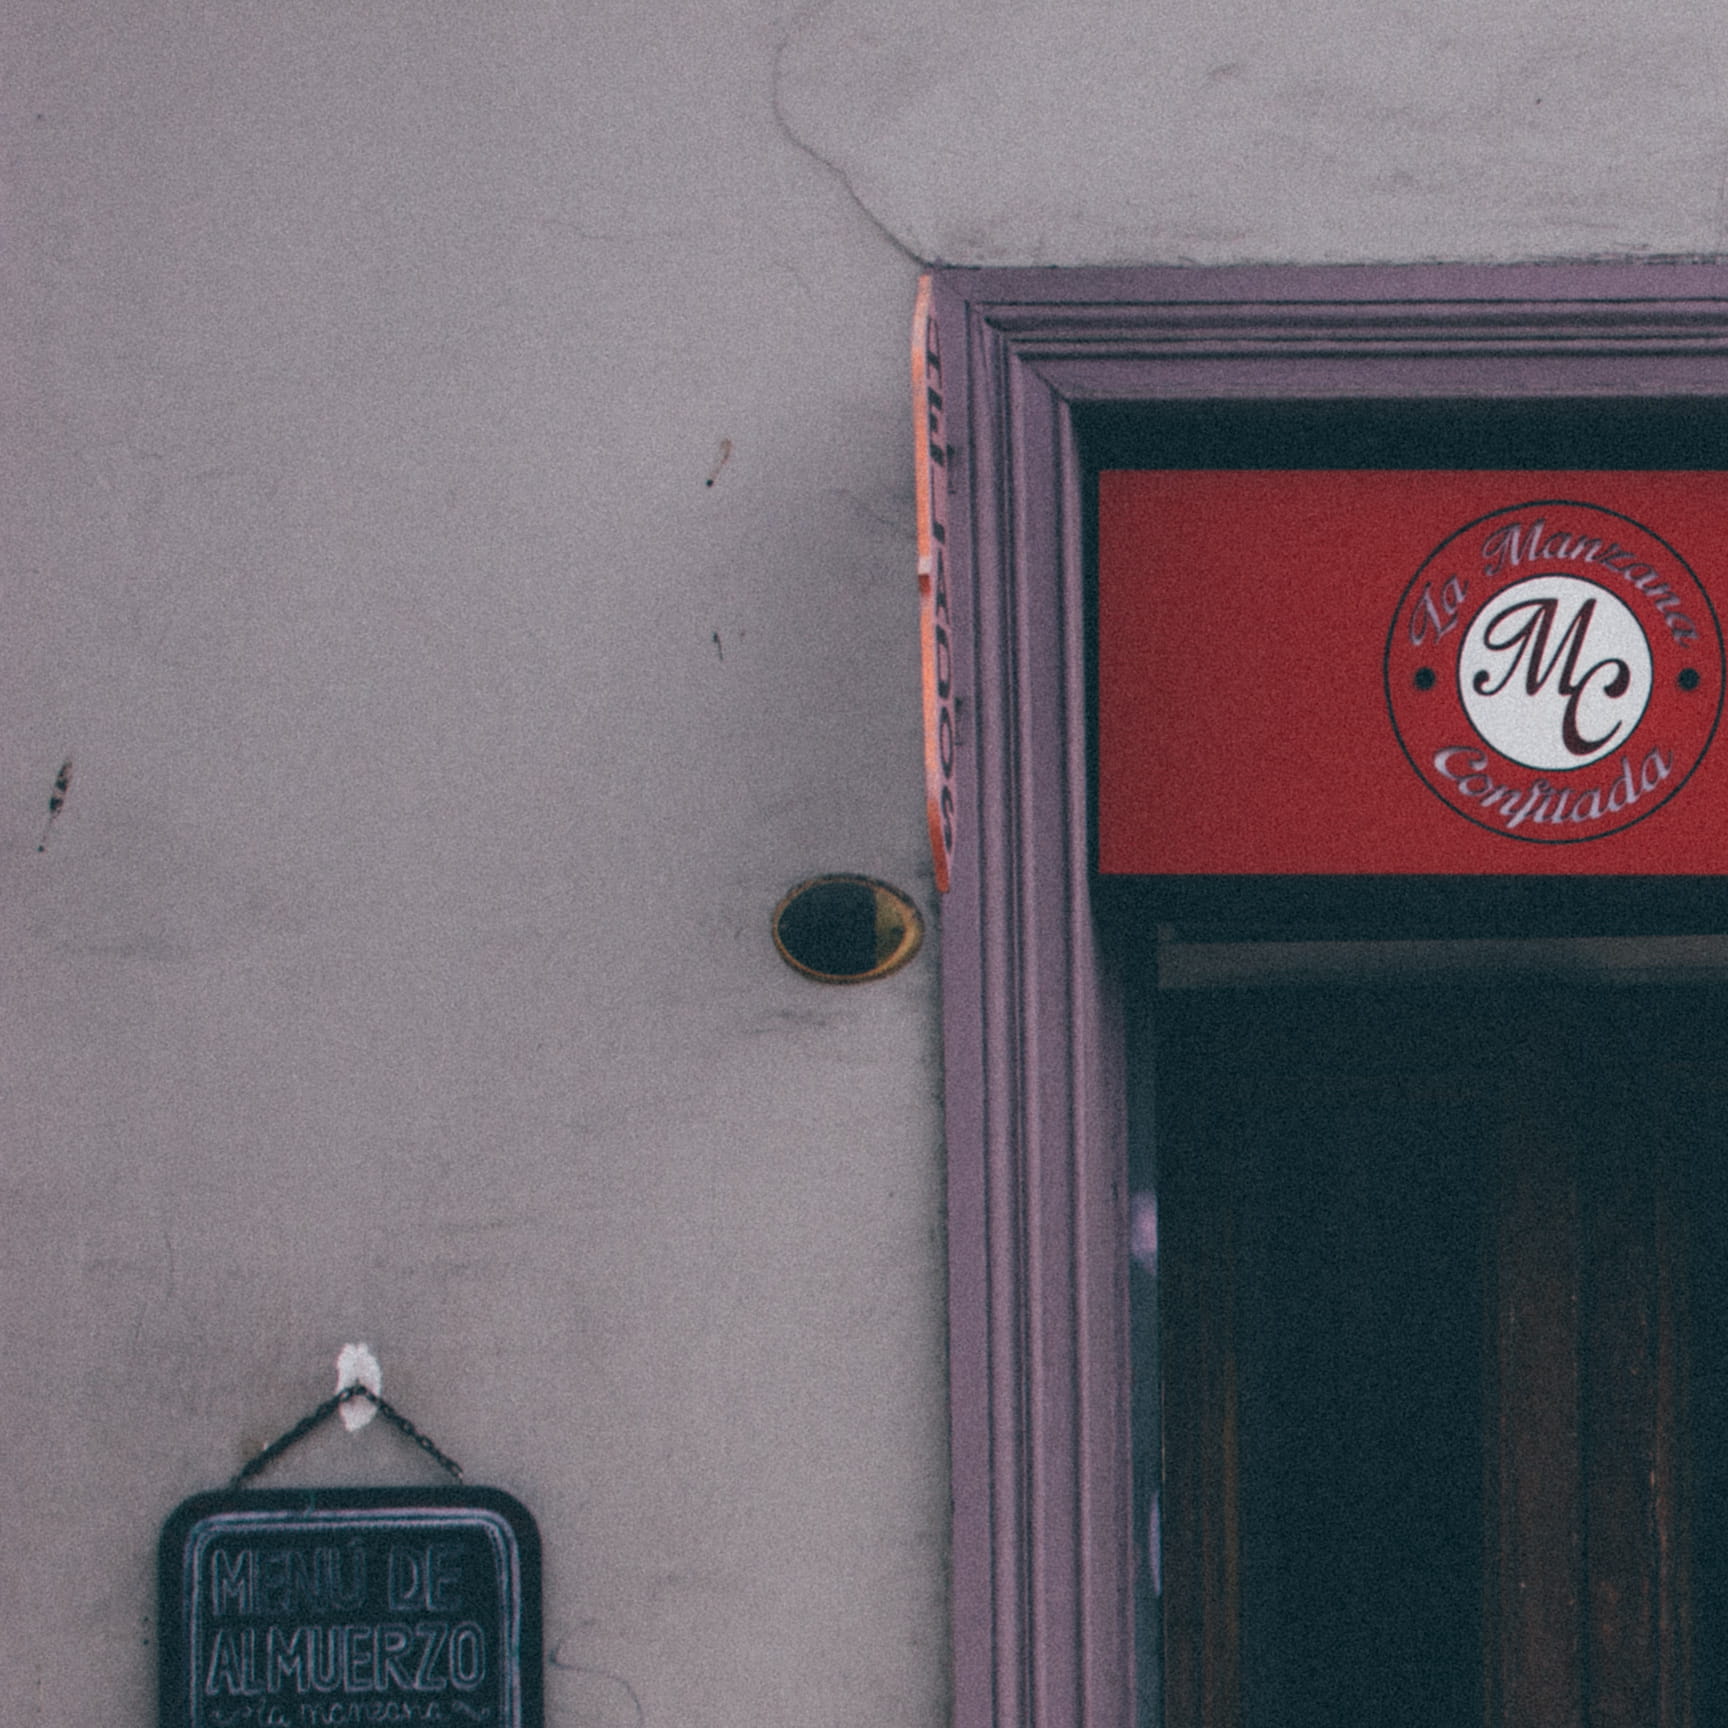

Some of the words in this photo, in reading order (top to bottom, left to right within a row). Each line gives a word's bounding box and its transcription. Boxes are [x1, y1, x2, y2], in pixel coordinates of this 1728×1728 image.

[1408, 573, 1469, 647] La
[1480, 517, 1699, 649] Manzana
[387, 1540, 467, 1613] DE
[205, 1620, 487, 1697] ALMUERZO
